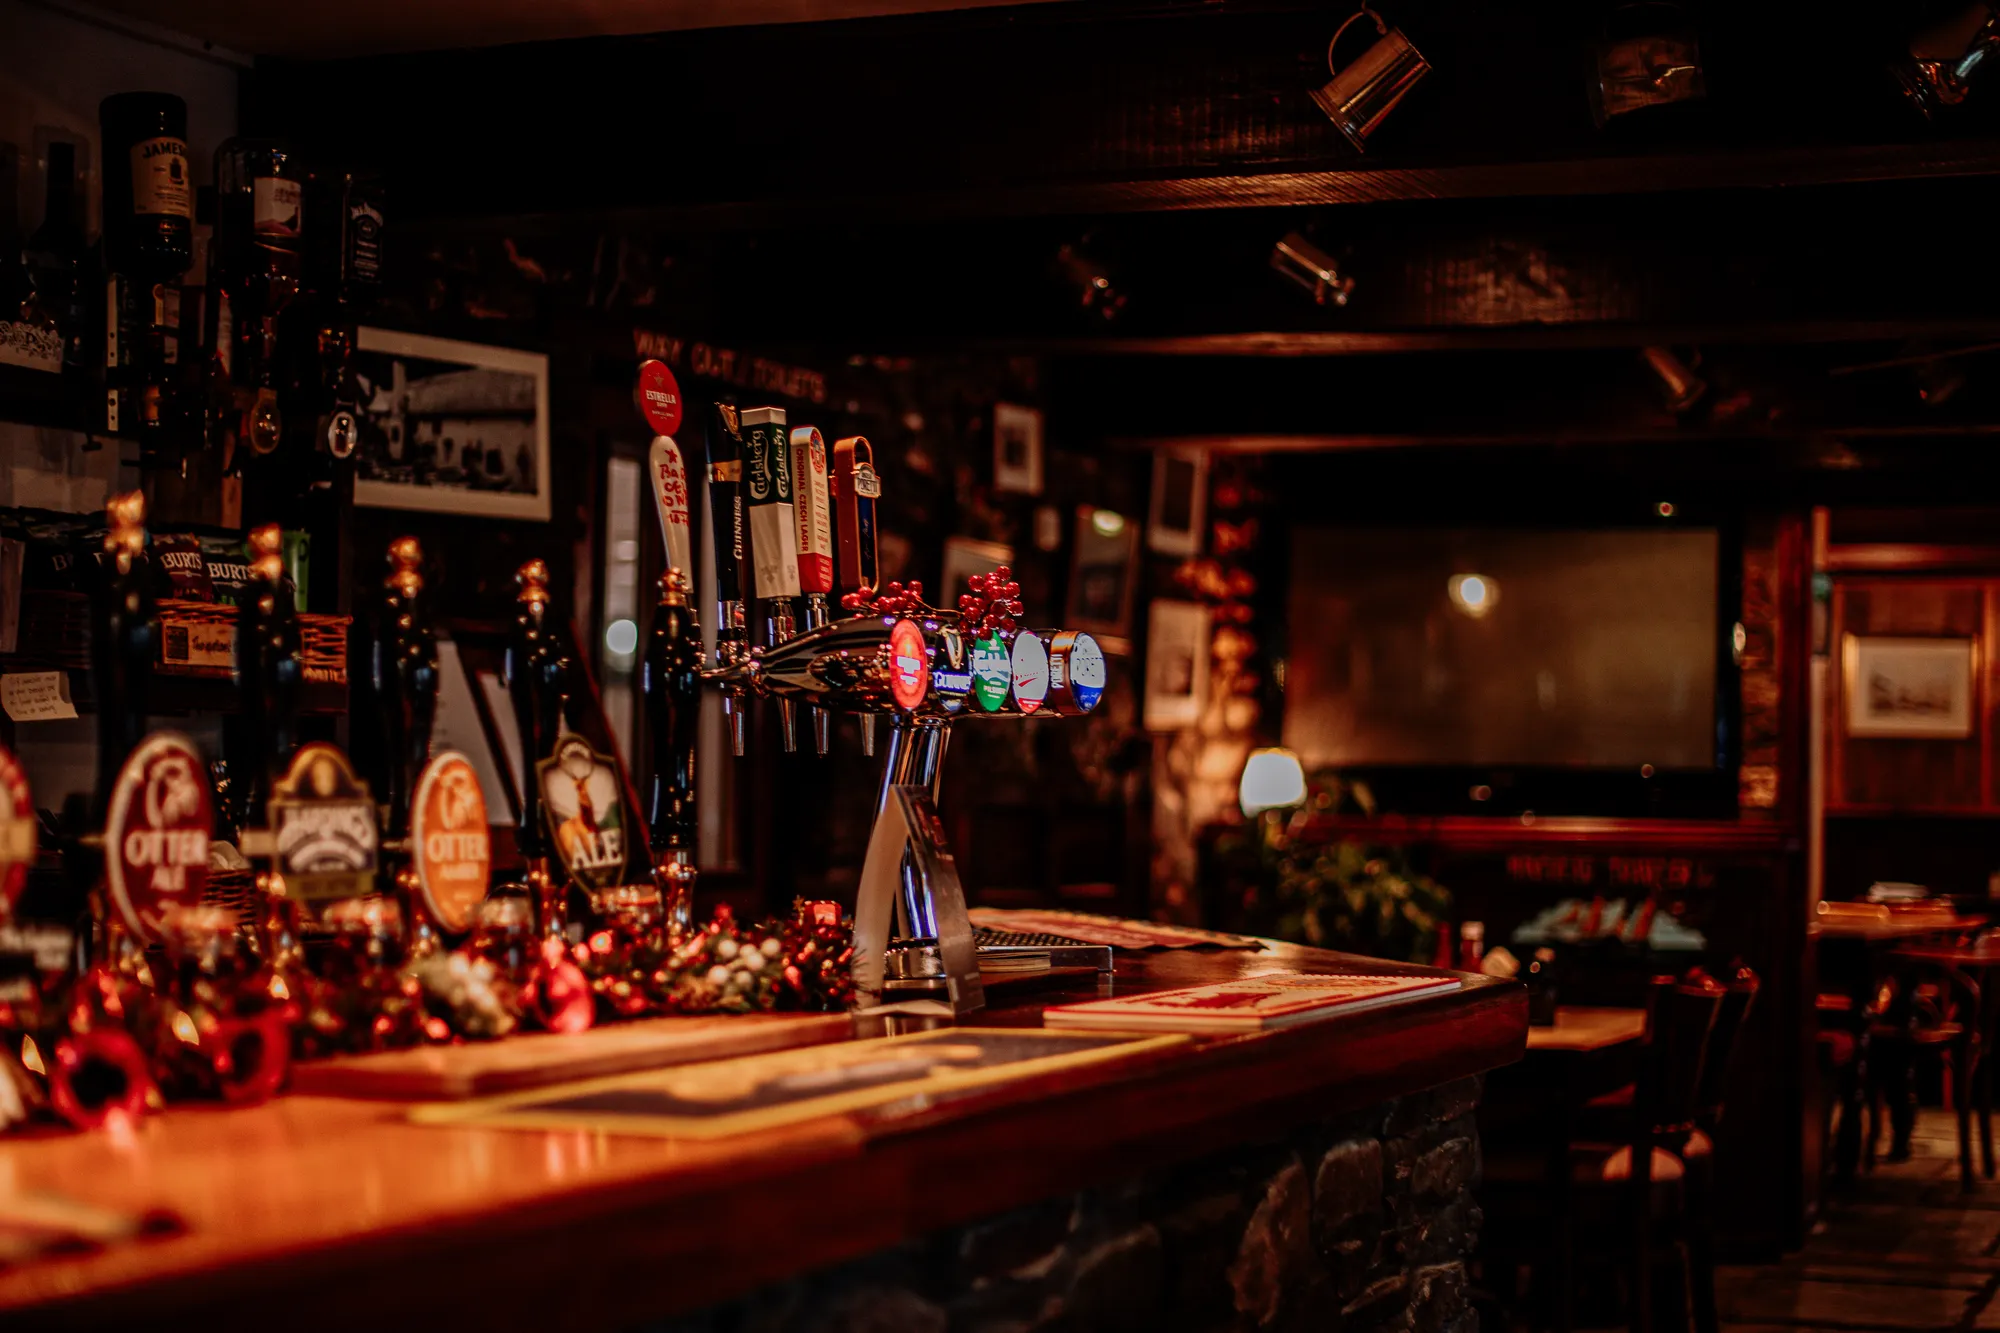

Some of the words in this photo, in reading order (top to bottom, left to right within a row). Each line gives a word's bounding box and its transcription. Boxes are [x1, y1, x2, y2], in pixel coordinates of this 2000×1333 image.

[691, 342, 737, 384] OUT
[645, 389, 677, 404] ESTRELLA
[749, 429, 772, 500] Carlsberg
[775, 428, 790, 498] Carlsberg
[796, 448, 806, 491] ORIGINAL
[733, 495, 743, 560] GUINNESS
[799, 494, 809, 522] CZECH
[801, 524, 809, 552] LAGER
[160, 551, 202, 570] BURTS
[124, 828, 209, 866] OTTER
[426, 832, 490, 863] OTTER
[570, 828, 623, 869] ALE
